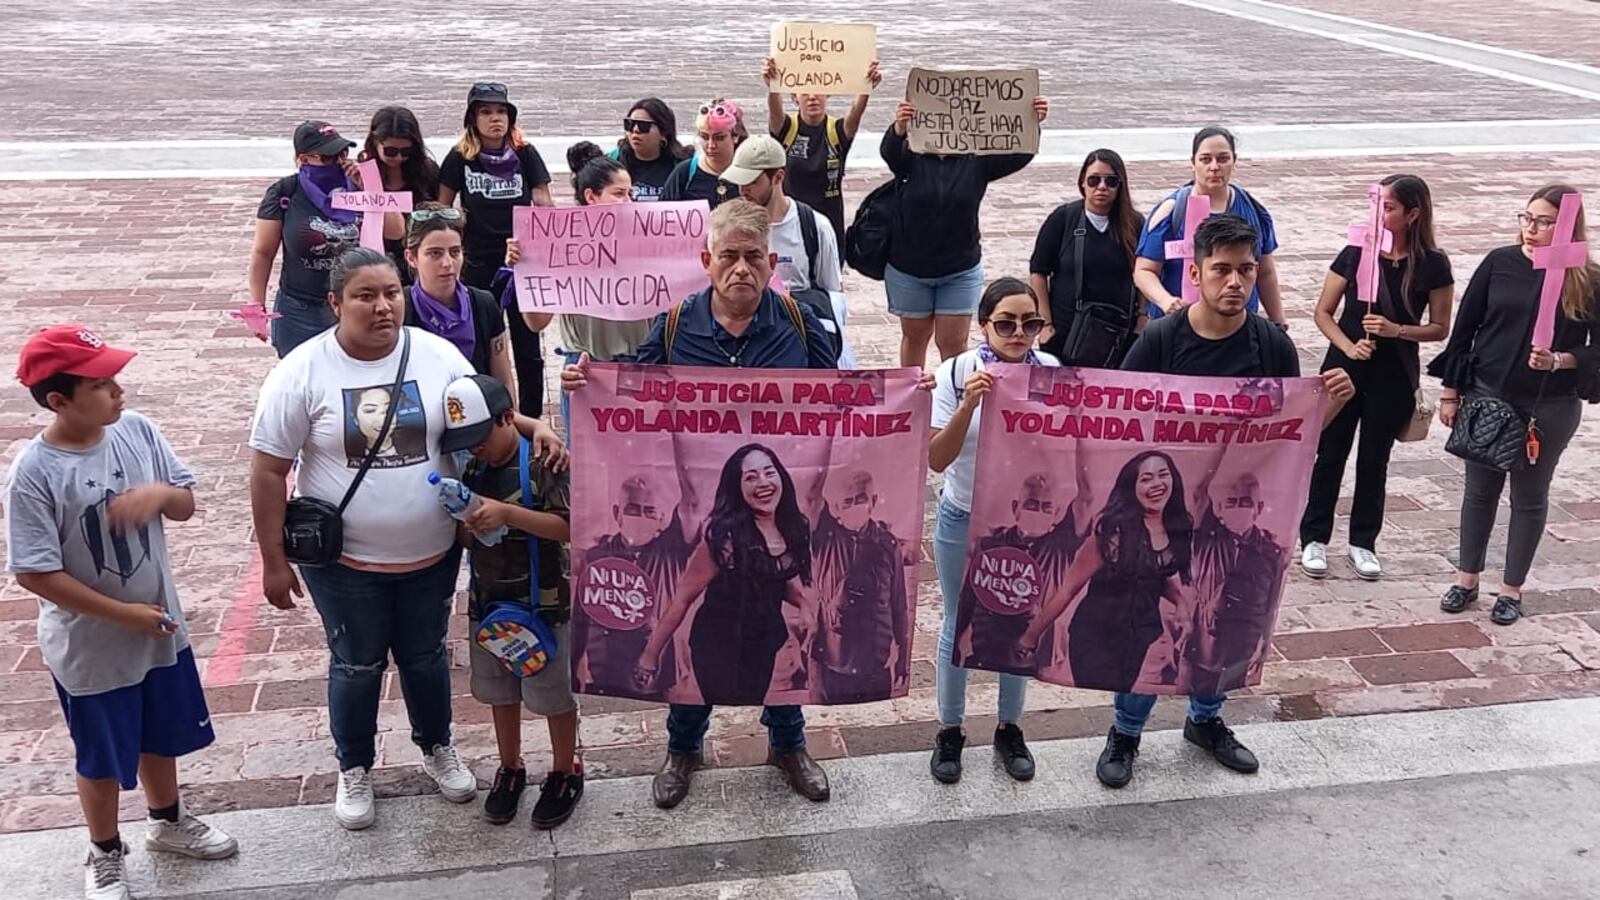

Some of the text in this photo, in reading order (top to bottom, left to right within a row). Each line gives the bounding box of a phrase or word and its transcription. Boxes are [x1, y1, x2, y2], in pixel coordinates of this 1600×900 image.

[777, 26, 845, 52] Justicia
[799, 53, 823, 63] para
[777, 67, 844, 88] YOLANDA
[949, 97, 986, 116] PAZ
[910, 111, 1024, 134] HASTA QUE HAYA
[929, 131, 1022, 152] JUSTICIA
[340, 193, 399, 208] YOLANDA
[530, 208, 704, 241] NUEVO NUEVO
[548, 239, 618, 269] LEÓN
[524, 274, 672, 309] FEMINICIDA
[633, 380, 876, 406] JUSTICIA PARA
[1043, 383, 1273, 418] JUSTICIA PARA
[590, 406, 912, 438] YOLANDA MARTÍNEZ
[1001, 409, 1304, 444] YOLANDA MARTÍNEZ
[611, 569, 649, 592] UNA
[974, 569, 1040, 596] MENOS
[1001, 559, 1036, 581] UNA
[583, 586, 654, 610] MENOS
